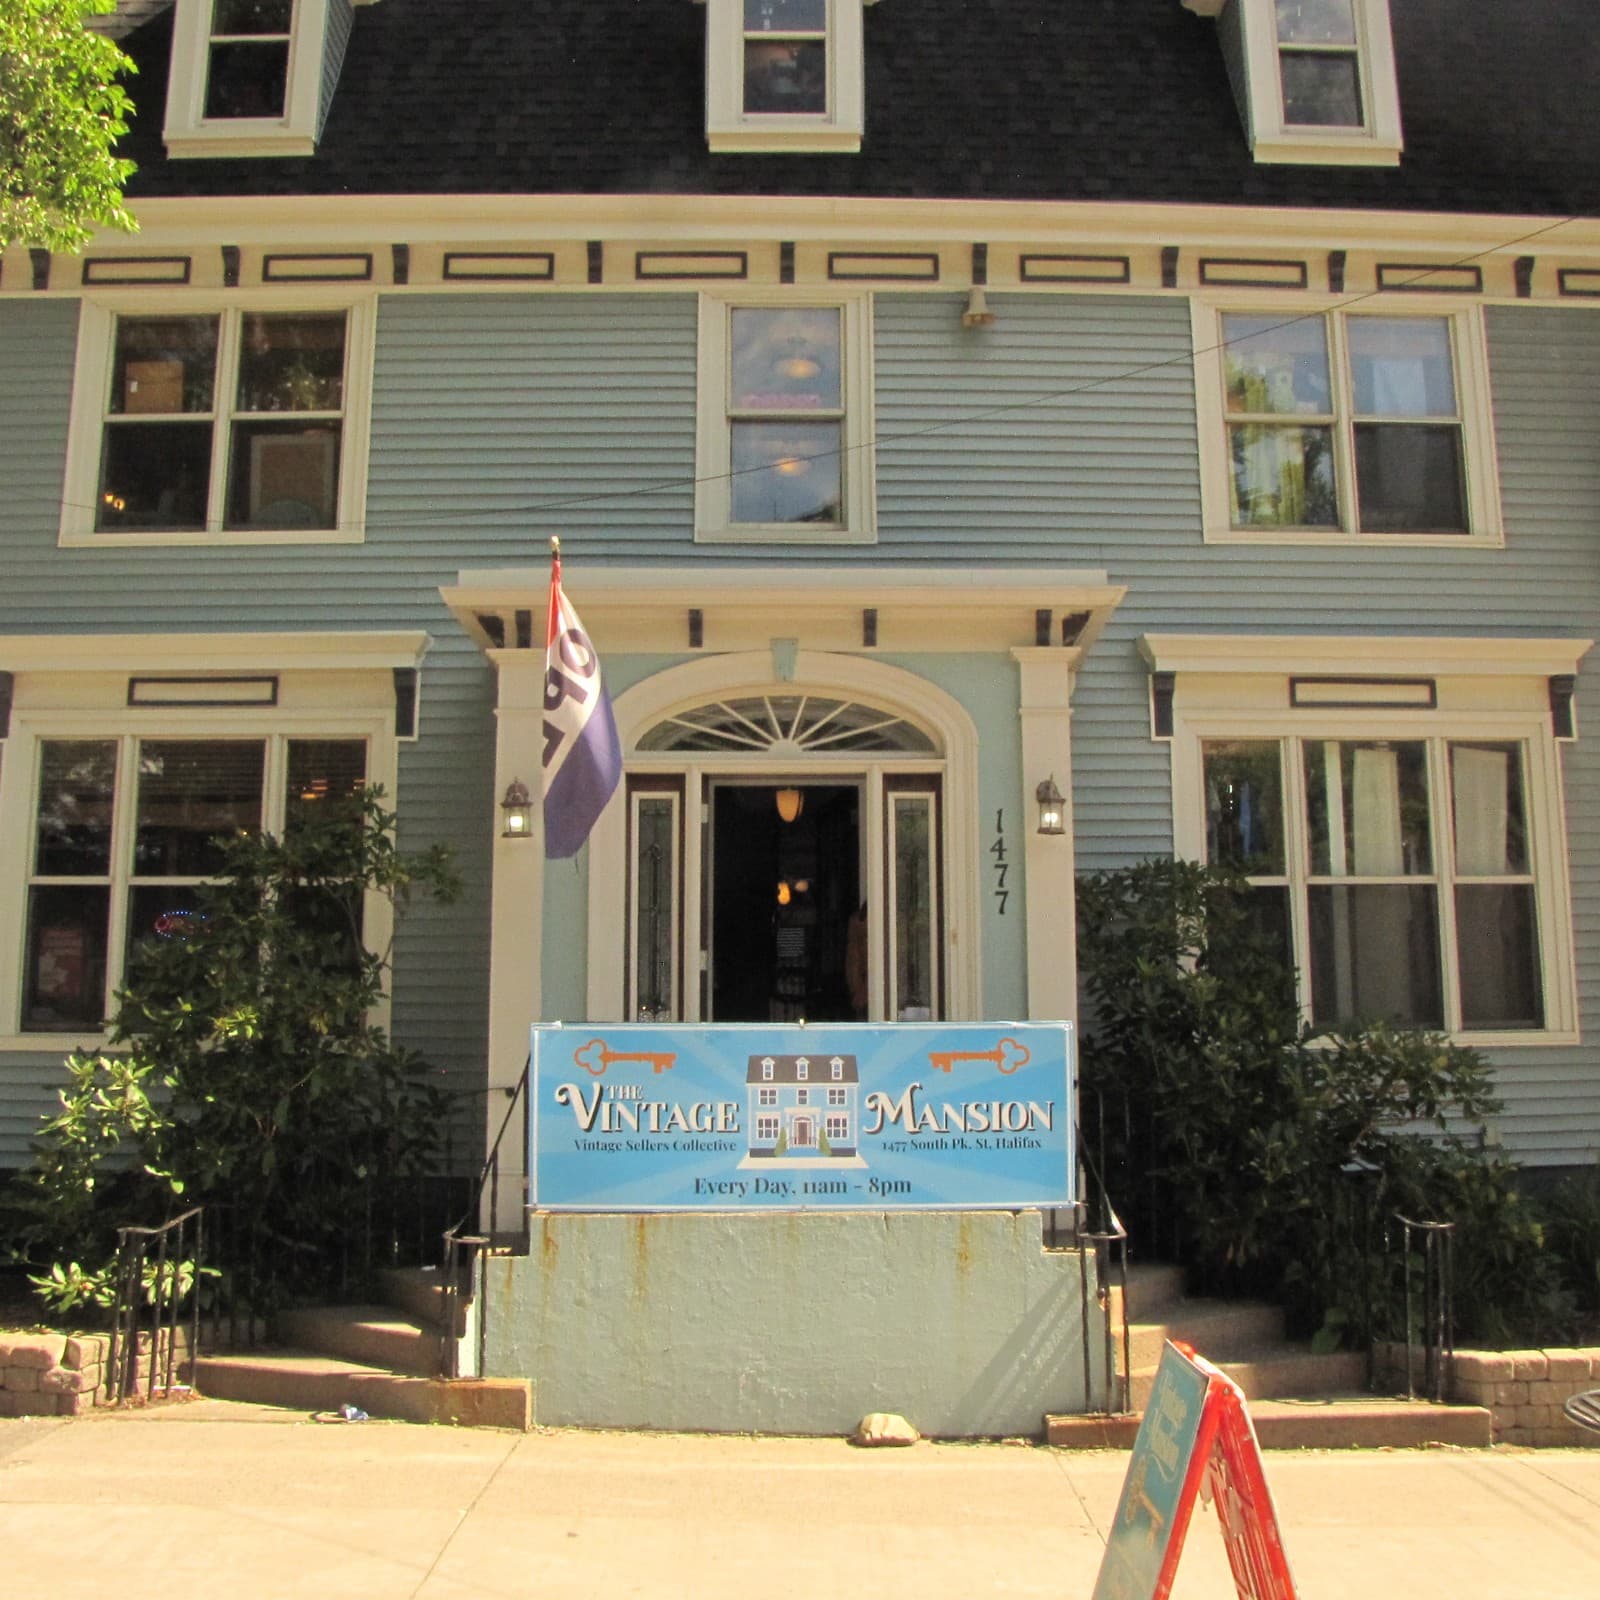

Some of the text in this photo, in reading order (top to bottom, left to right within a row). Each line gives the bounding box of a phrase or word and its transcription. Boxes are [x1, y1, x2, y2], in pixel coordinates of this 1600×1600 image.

[989, 808, 1009, 915] 1477
[606, 1085, 644, 1101] THE
[554, 1081, 1055, 1134] VINTAGE MANSION
[574, 1138, 737, 1153] Vintage Sellers Collective
[881, 1141, 907, 1153] 1477
[910, 1137, 948, 1151] South
[951, 1137, 972, 1151] Pk.
[995, 1136, 1041, 1151] Halifax
[693, 1177, 749, 1198] Every
[754, 1177, 797, 1198] Day,
[802, 1179, 848, 1195] 11am
[867, 1176, 912, 1197] 8pm
